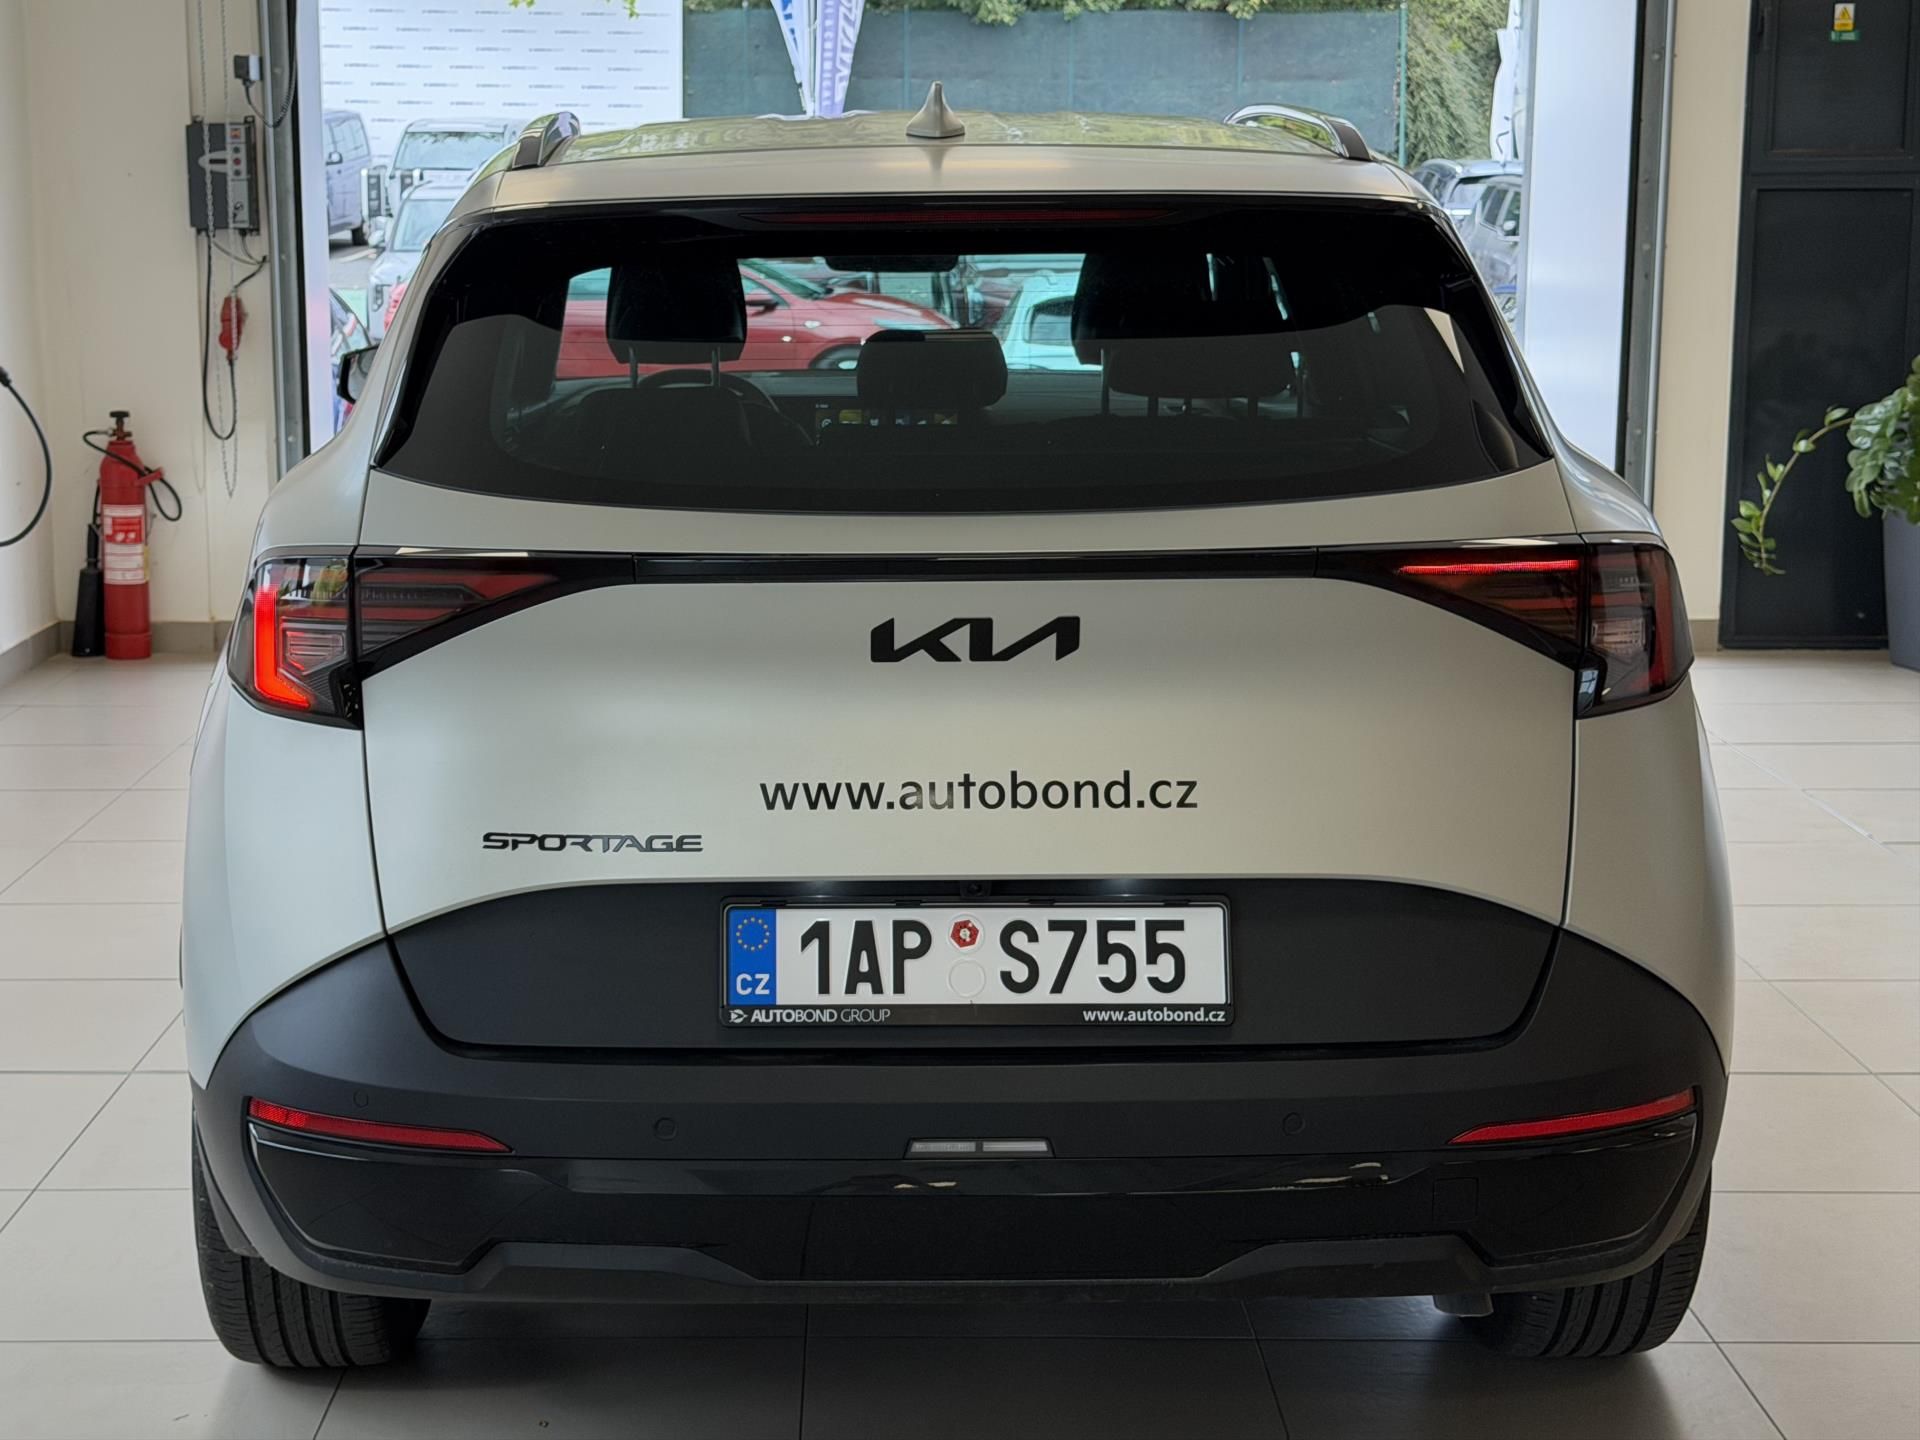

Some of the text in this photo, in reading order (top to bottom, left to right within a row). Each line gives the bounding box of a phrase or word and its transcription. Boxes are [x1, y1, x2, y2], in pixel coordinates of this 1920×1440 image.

[870, 616, 1080, 662] KIA
[759, 769, 1198, 811] www.autobond.cz
[482, 831, 704, 853] SPORTAGE
[800, 919, 1186, 995] 1AP S755
[736, 973, 770, 996] CZ
[750, 1008, 891, 1023] AUTOBOND GROUP
[1083, 1006, 1226, 1022] www.autobond.cz
